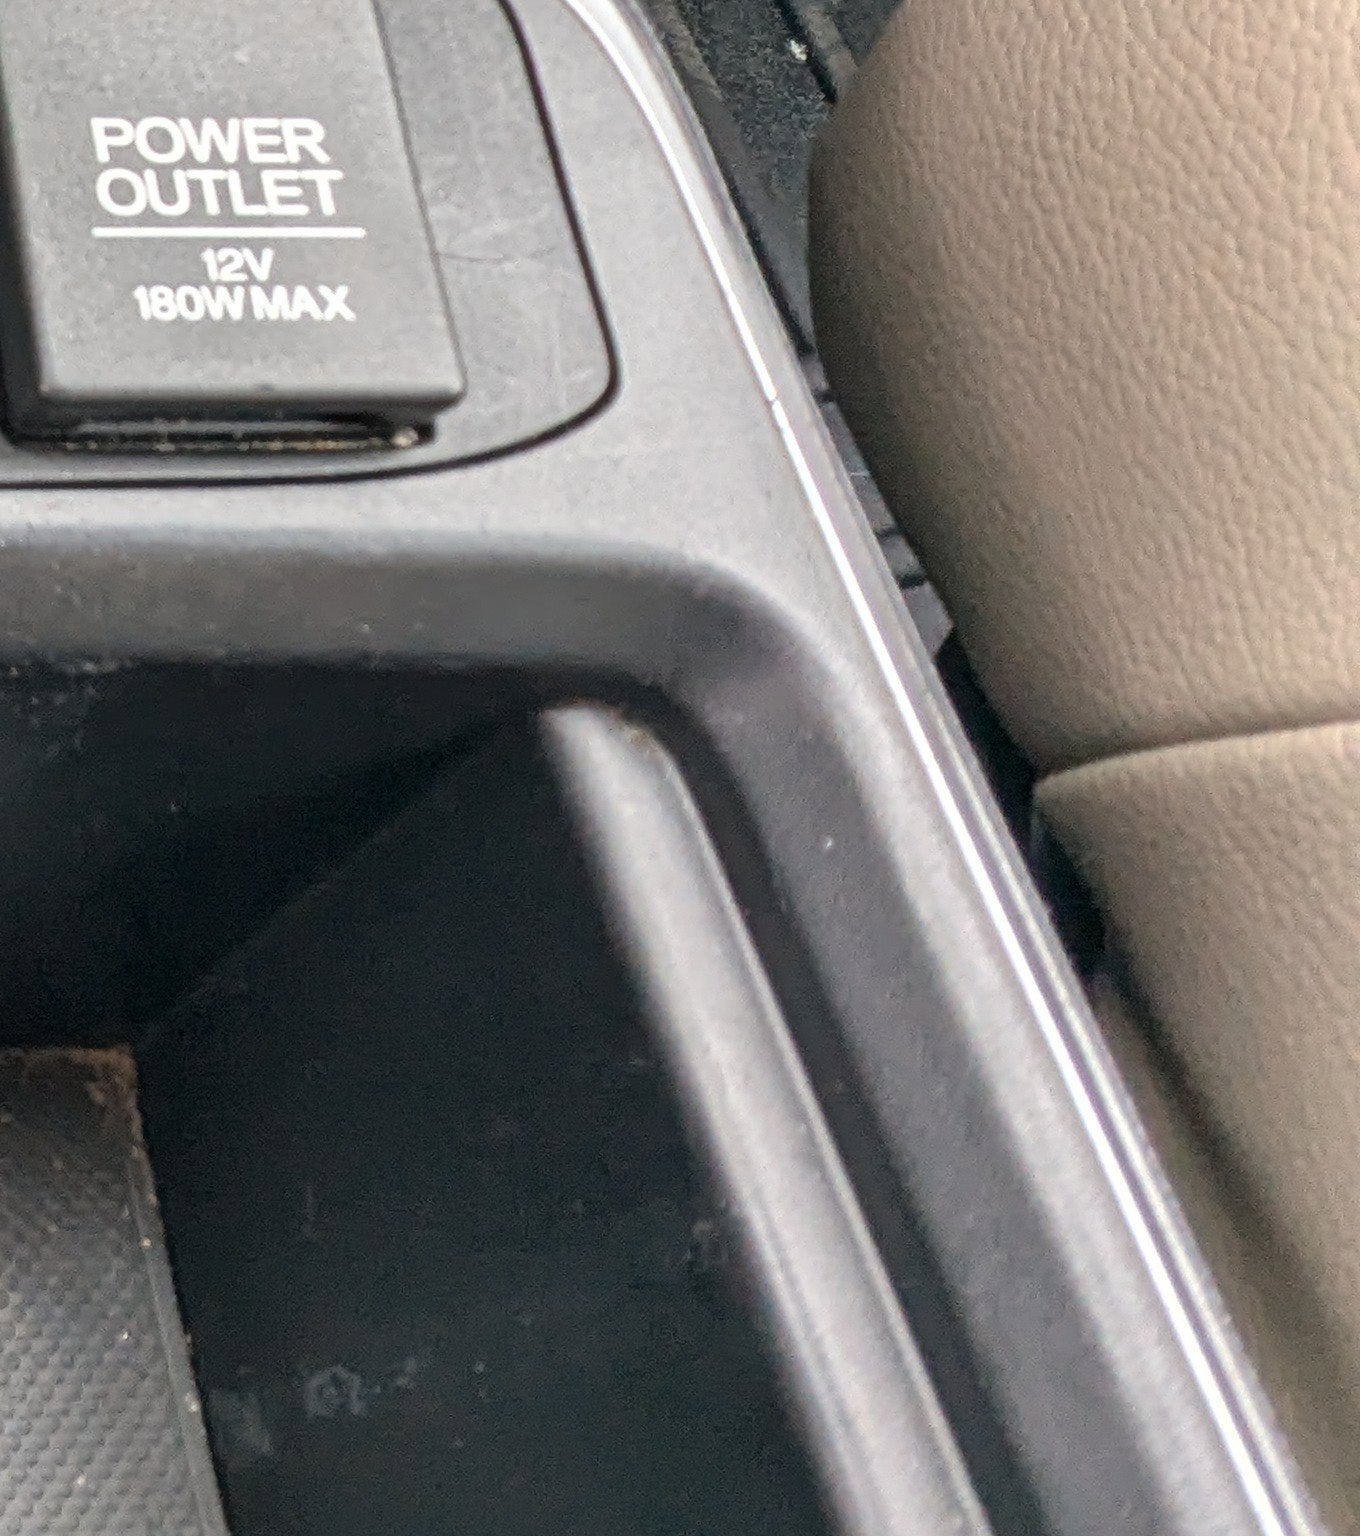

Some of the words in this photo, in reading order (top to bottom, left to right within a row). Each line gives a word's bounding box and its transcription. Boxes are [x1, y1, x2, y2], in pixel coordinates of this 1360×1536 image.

[90, 116, 331, 164] POWER
[94, 168, 344, 216] OUTLET
[200, 247, 275, 282] 12V
[133, 285, 245, 321] 180W
[251, 285, 356, 321] MAX
